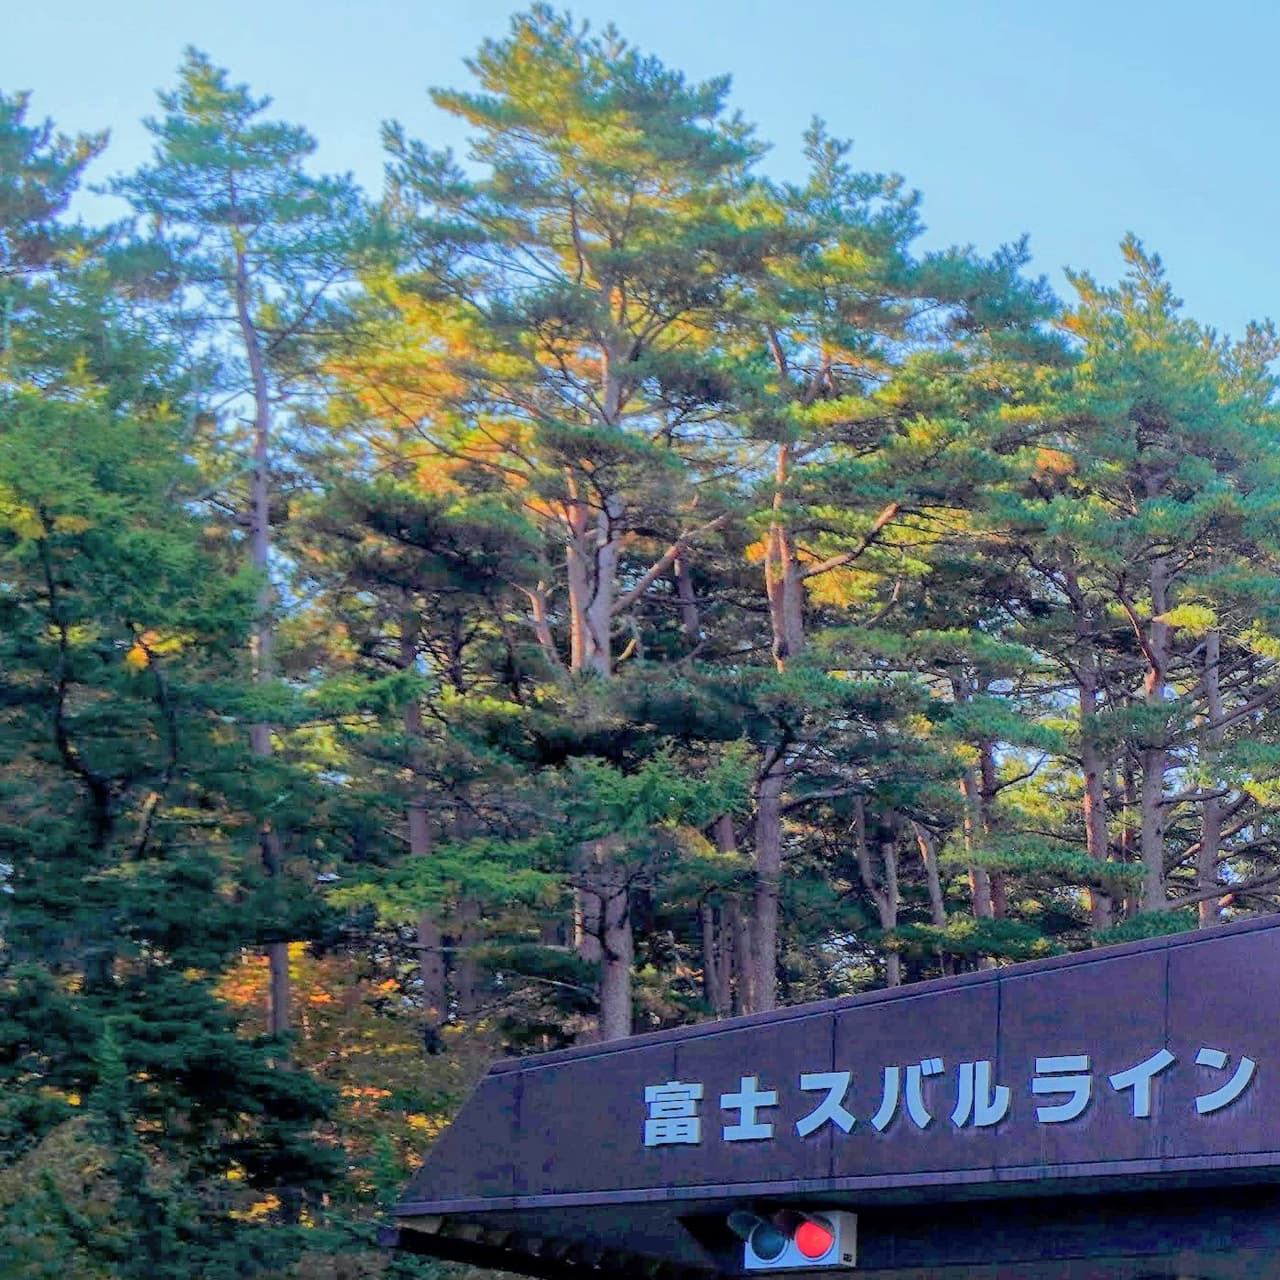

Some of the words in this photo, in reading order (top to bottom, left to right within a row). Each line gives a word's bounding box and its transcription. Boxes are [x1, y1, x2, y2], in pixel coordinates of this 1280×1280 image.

[643, 1047, 1256, 1147] 富士スバルライン
